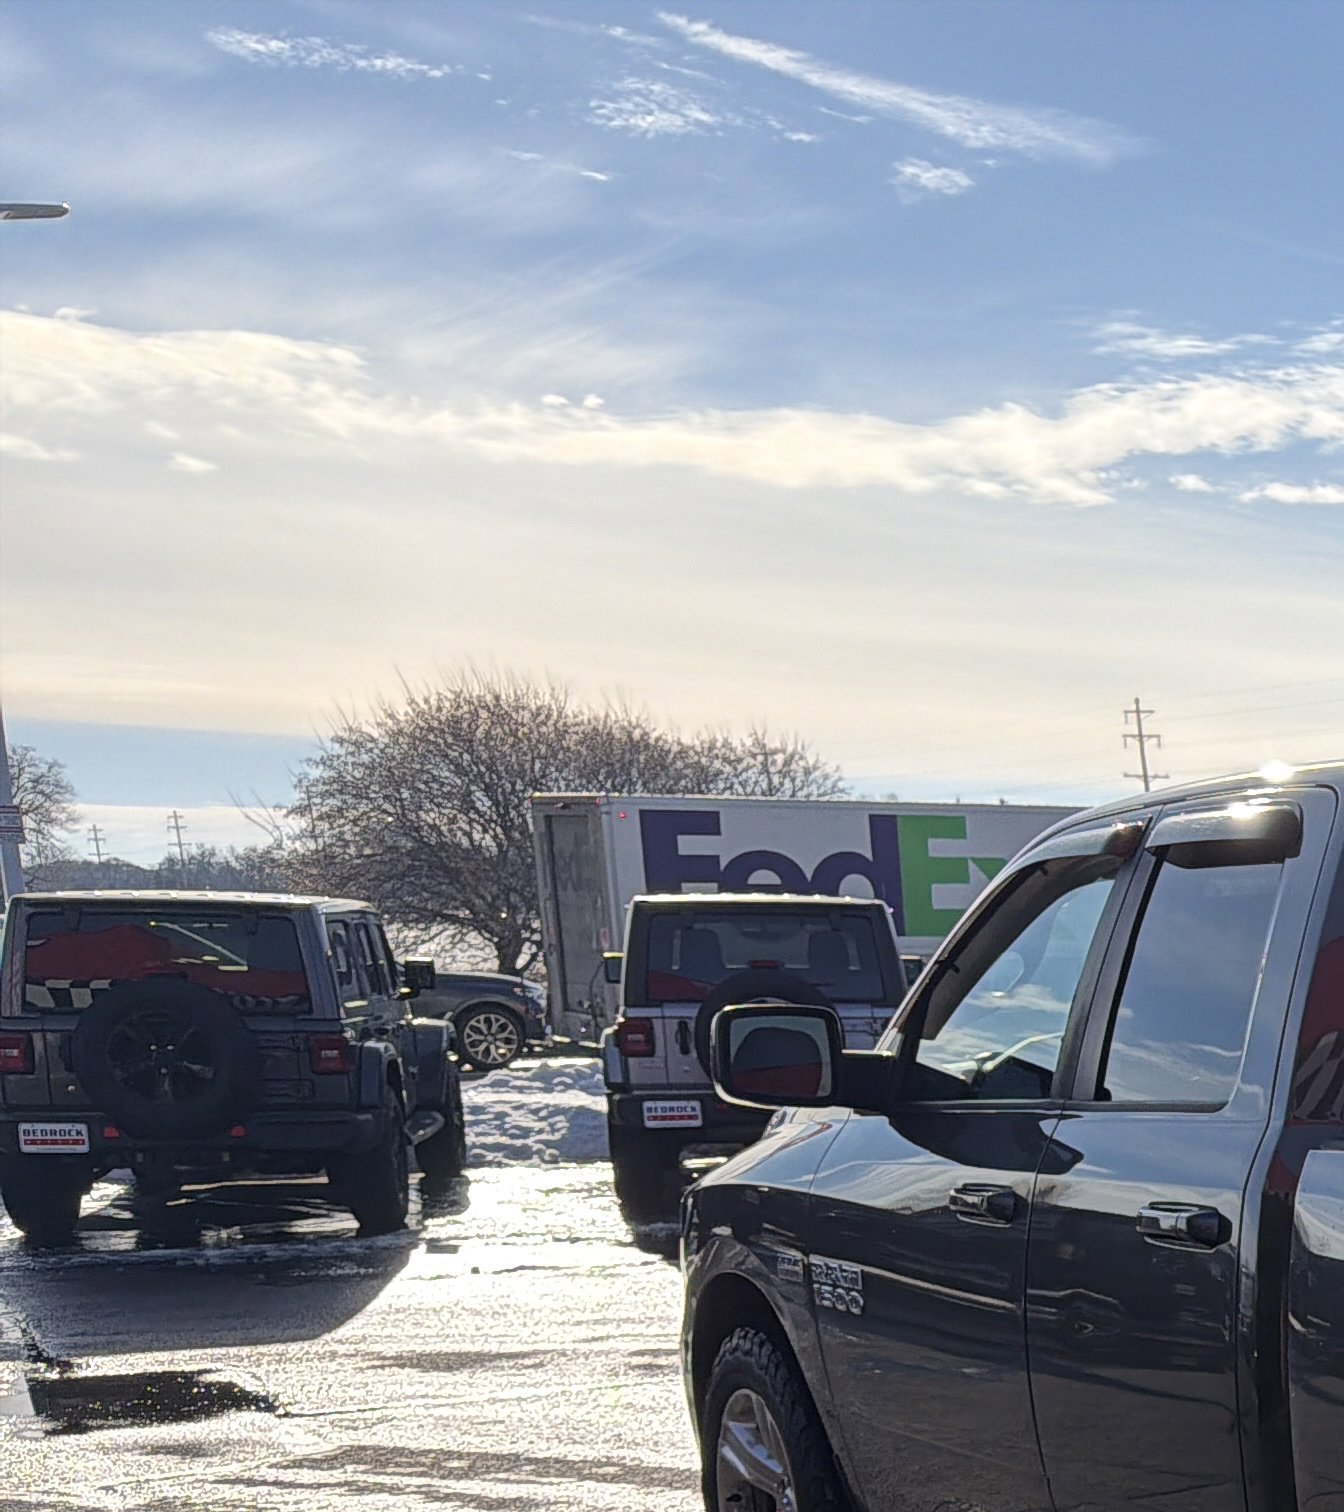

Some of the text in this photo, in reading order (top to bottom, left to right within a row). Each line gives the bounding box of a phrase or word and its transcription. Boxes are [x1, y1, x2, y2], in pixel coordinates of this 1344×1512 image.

[639, 809, 1009, 937] FedE
[22, 1128, 84, 1138] BEDROCK
[813, 1283, 864, 1315] 1500
